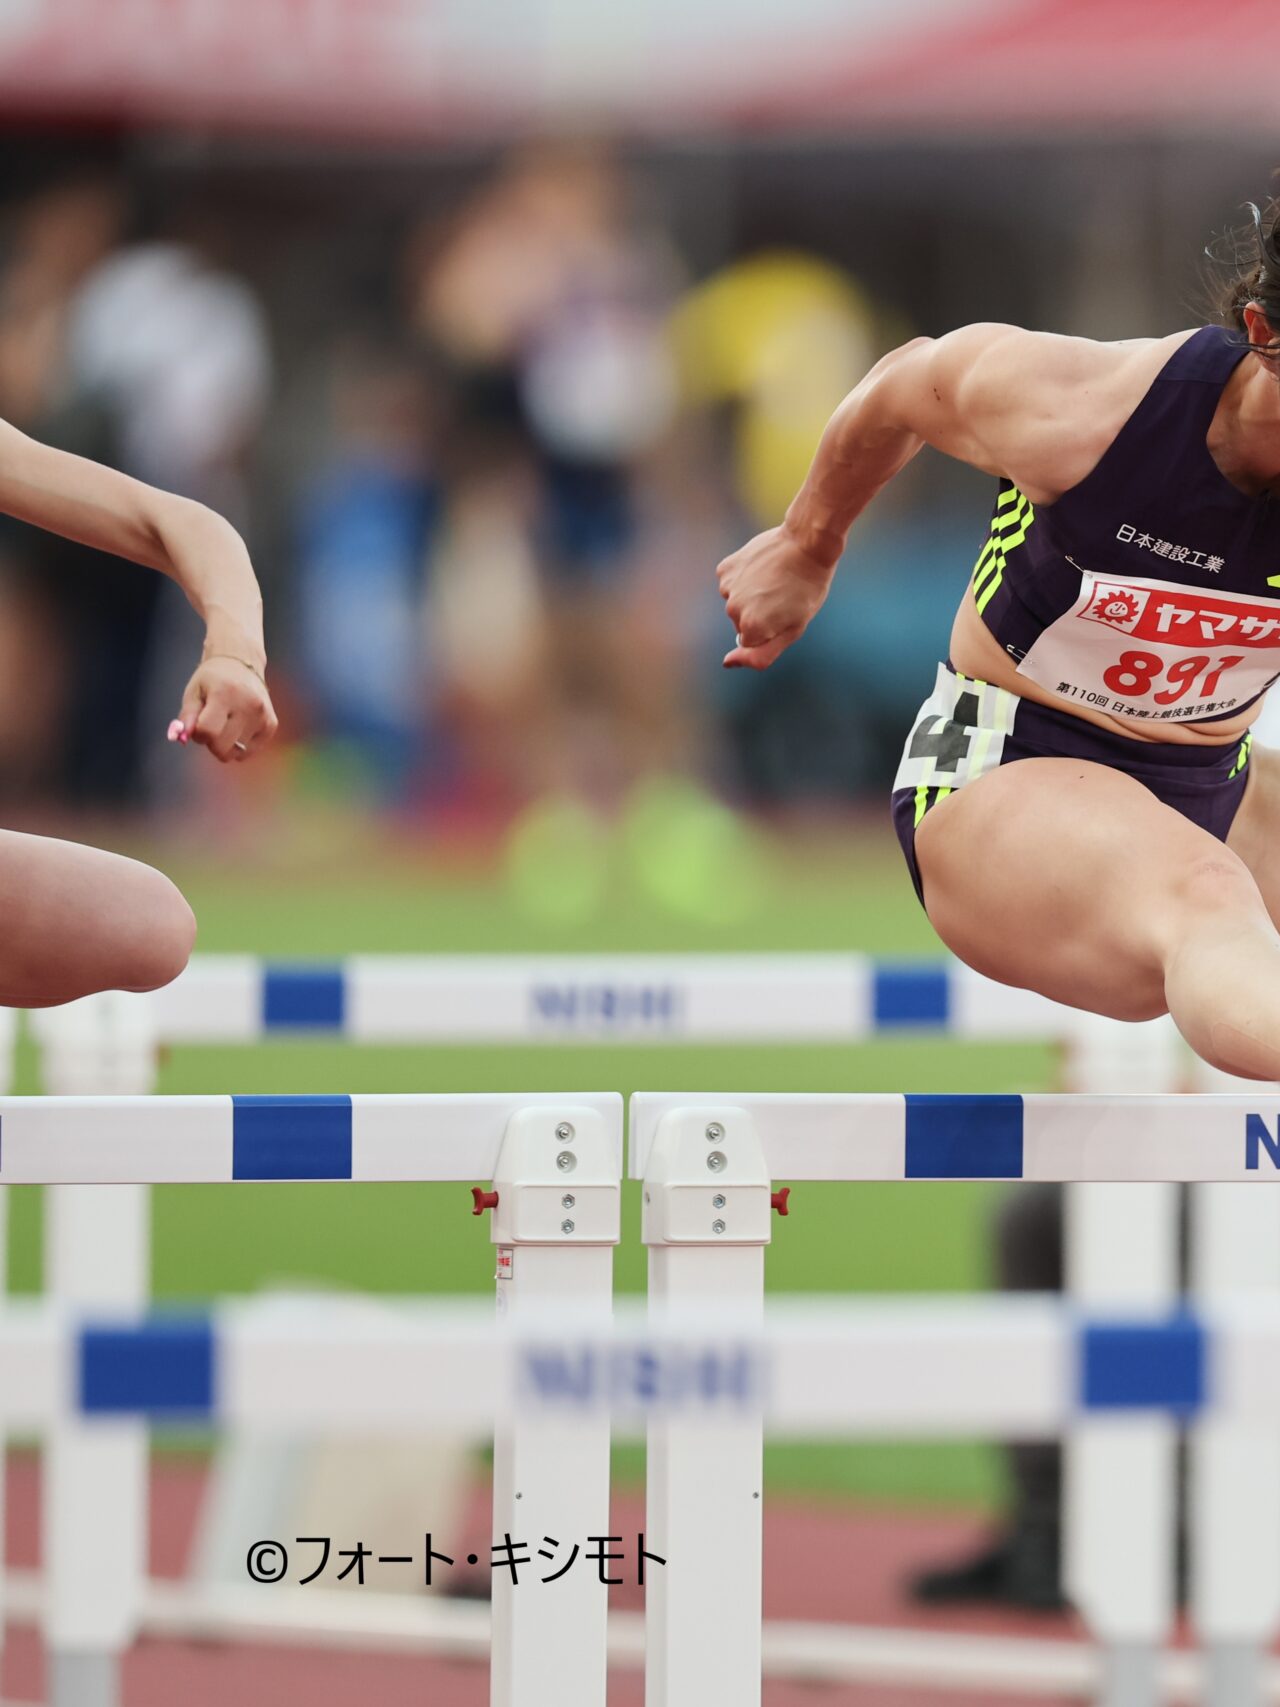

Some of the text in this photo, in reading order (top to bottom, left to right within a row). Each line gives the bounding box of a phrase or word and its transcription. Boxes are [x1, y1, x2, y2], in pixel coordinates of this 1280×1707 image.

[1116, 523, 1225, 574] 日本建設工業
[1055, 681, 1237, 720] 第110回 日本陸上競技選手権大会
[1102, 650, 1245, 705] 891
[908, 691, 980, 773] 4
